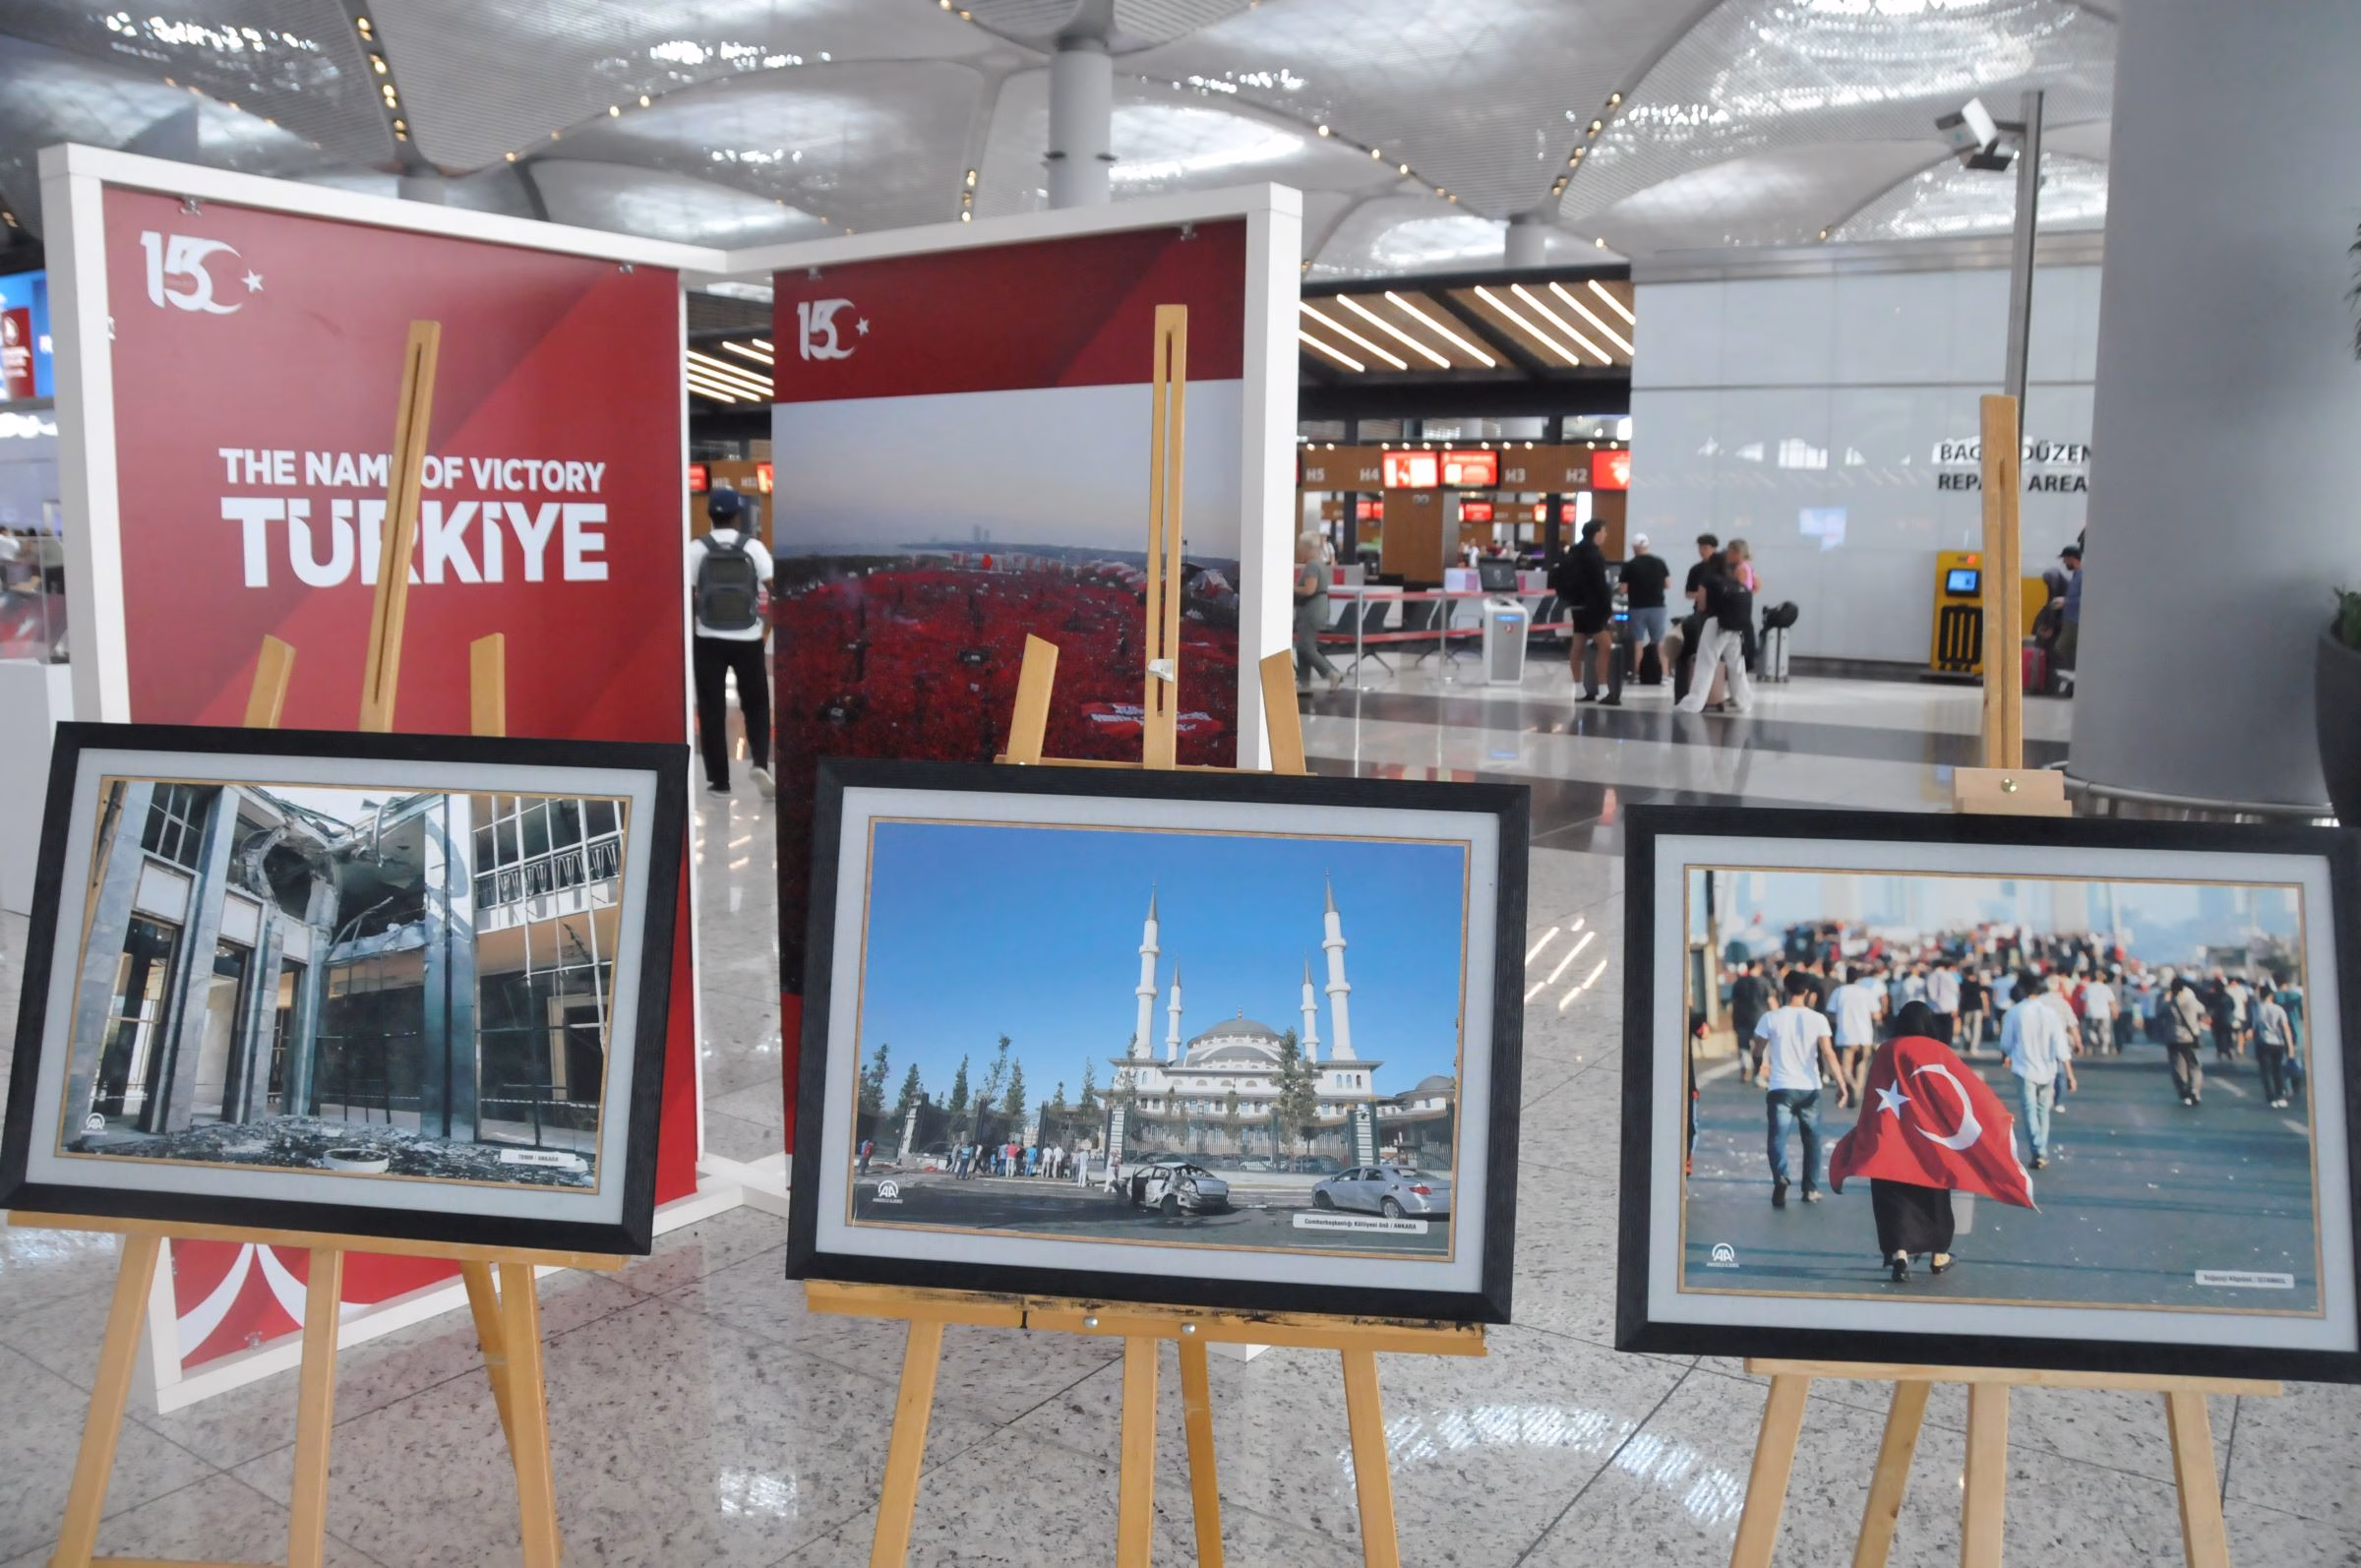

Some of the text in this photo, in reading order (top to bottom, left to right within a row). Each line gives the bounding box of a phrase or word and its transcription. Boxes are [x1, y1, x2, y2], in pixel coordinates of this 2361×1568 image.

[218, 448, 606, 493] THE NAM OF VICTORY
[1360, 467, 1379, 482] H4
[1505, 467, 1526, 483] H3
[1565, 467, 1588, 483] H2
[1938, 473, 2088, 492] REP AREA
